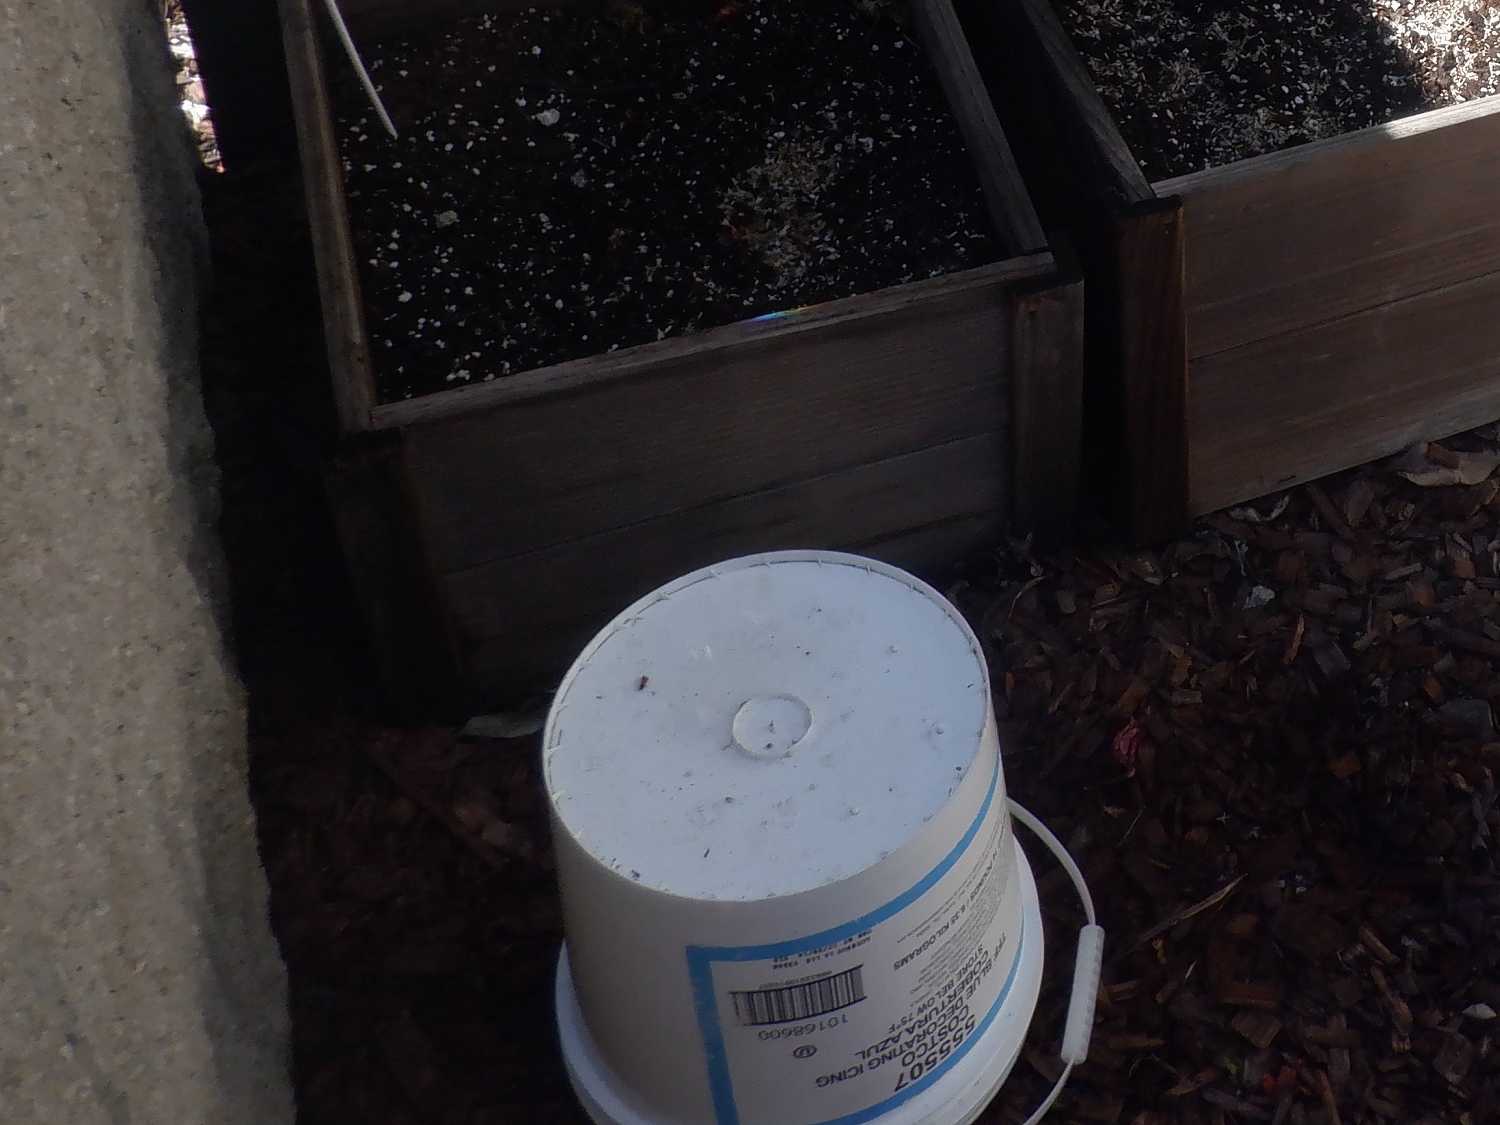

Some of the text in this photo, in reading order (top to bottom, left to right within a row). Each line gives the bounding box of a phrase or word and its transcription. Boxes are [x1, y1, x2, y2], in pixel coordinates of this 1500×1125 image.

[893, 922, 950, 971] KILOGRAMS
[956, 944, 983, 983] STORE
[904, 949, 989, 1035] COBERTURA
[917, 979, 955, 1016] BELOW
[966, 958, 992, 1000] BLUE
[854, 1030, 902, 1060] AZUL
[868, 996, 964, 1070] DECORATING
[894, 1013, 976, 1092] 555507
[901, 1004, 969, 1067] COSTCO
[815, 1064, 865, 1088] ICING
